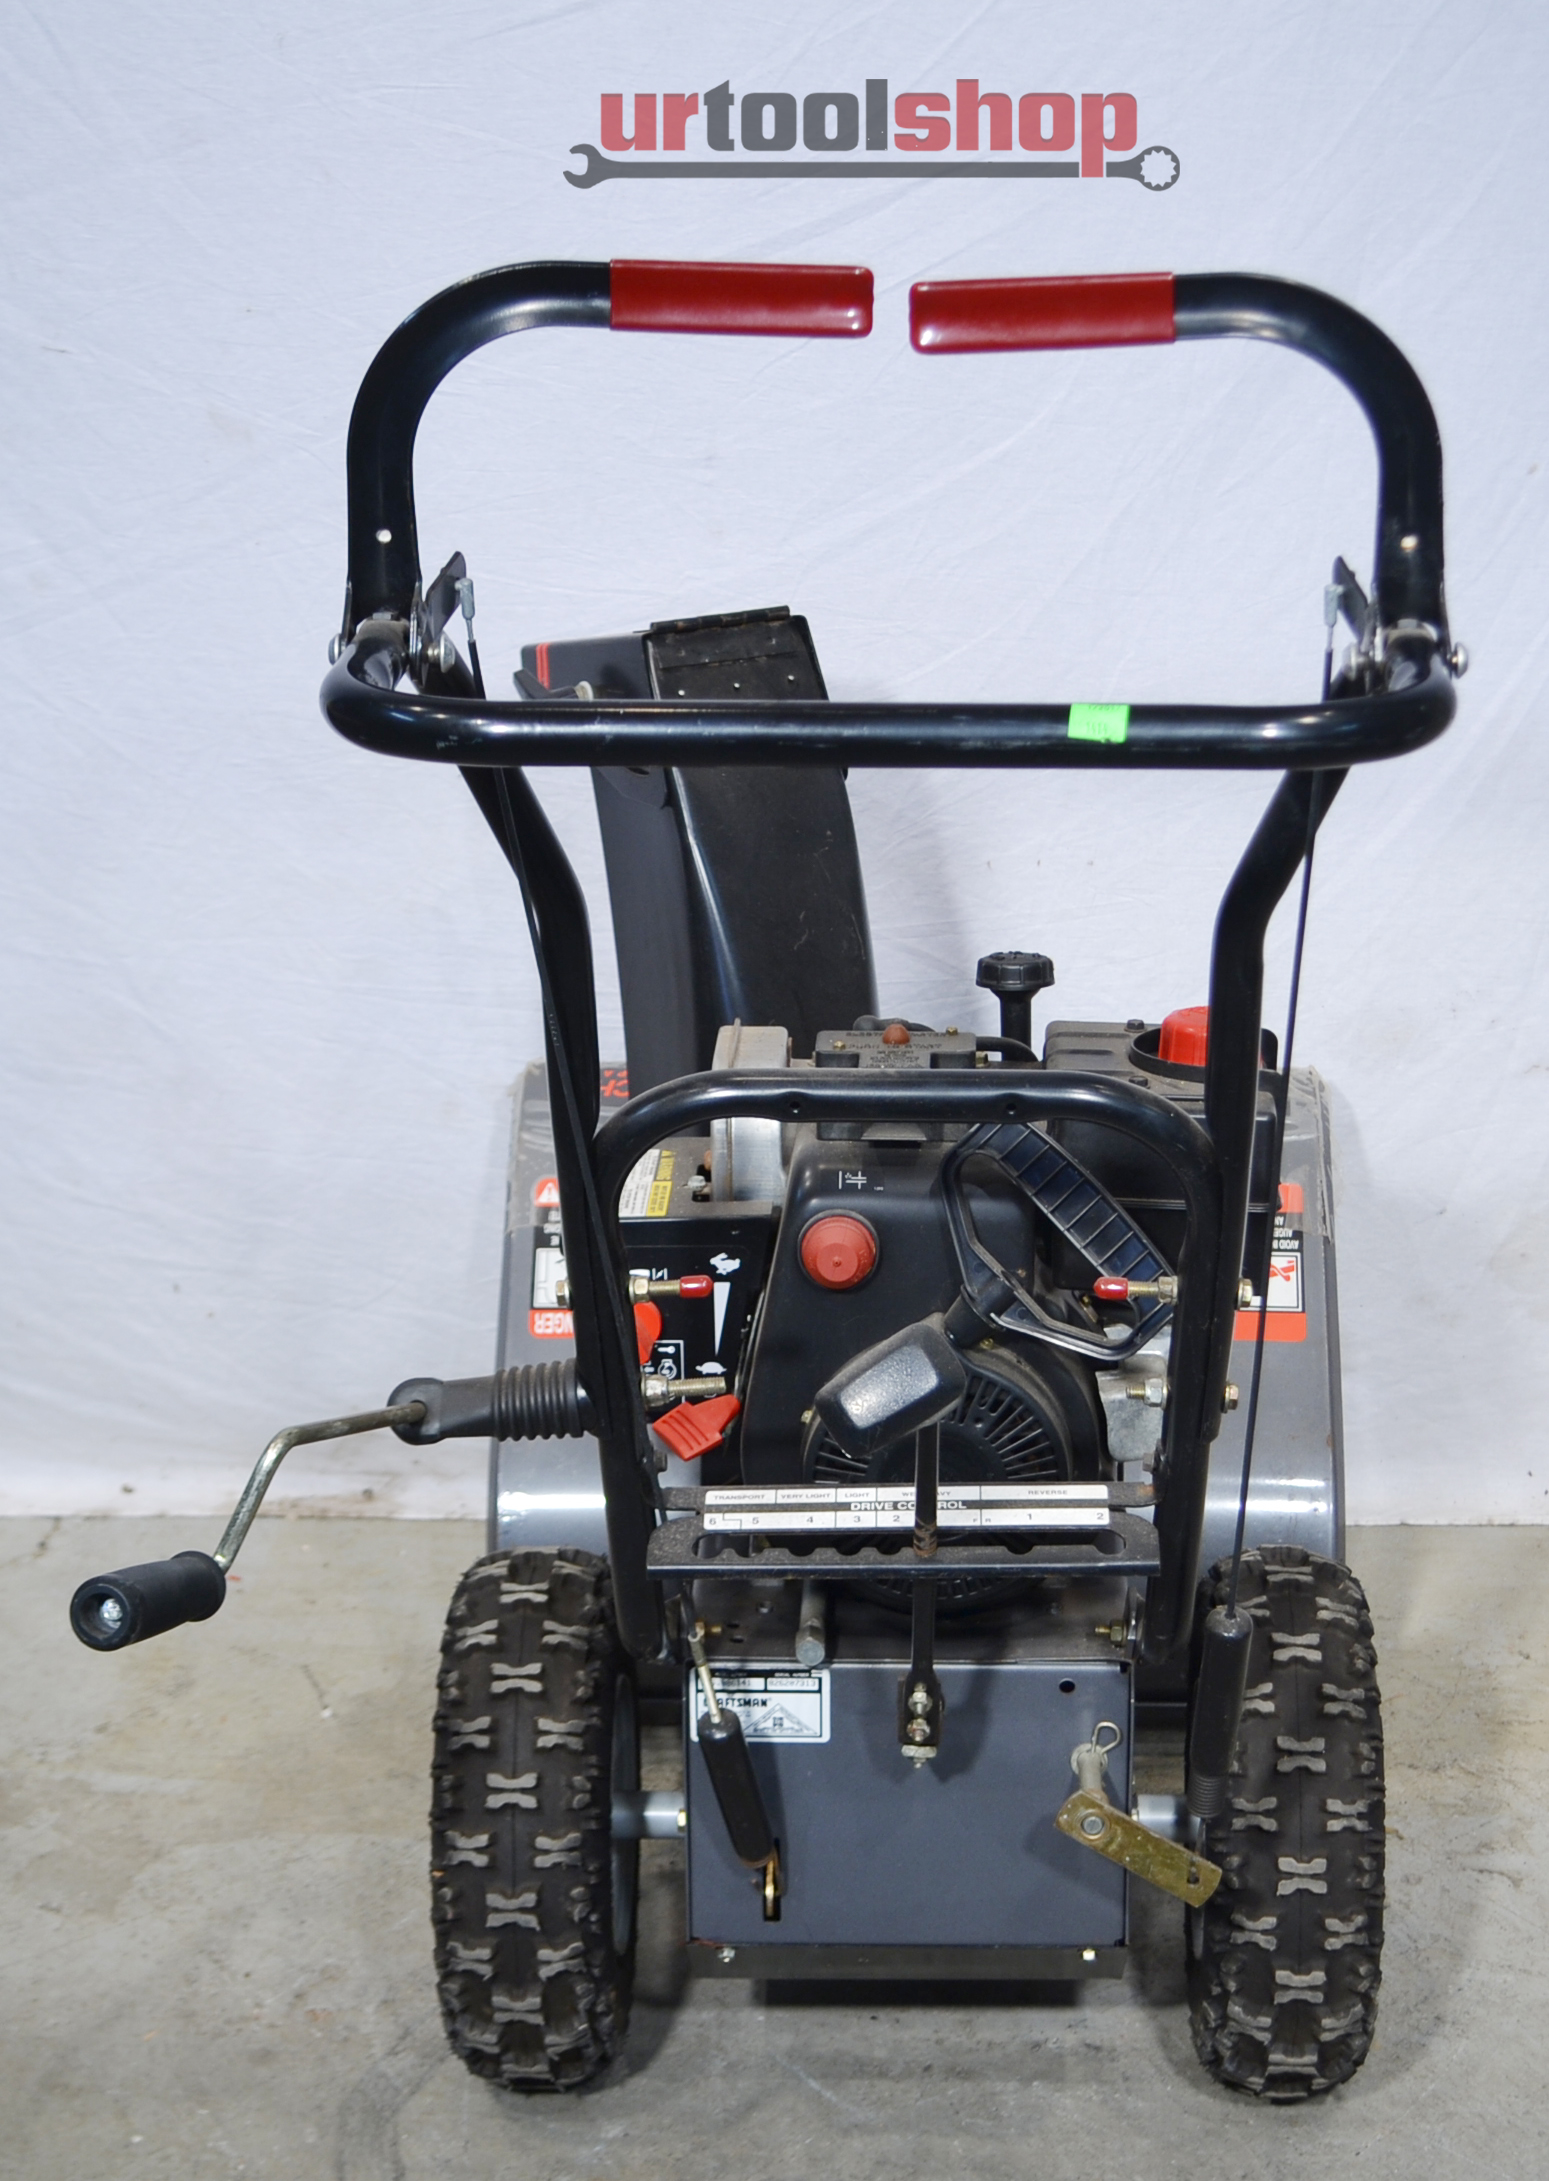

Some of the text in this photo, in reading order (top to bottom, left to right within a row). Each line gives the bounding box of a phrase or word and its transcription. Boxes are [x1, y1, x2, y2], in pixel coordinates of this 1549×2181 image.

[850, 1500, 967, 1511] DRIVE COROL
[806, 1515, 814, 1523] 4
[853, 1515, 861, 1523] 3
[893, 1514, 900, 1522] 2
[1097, 1512, 1104, 1520] 2
[709, 1517, 716, 1525] 6
[752, 1516, 759, 1525] 5
[704, 1698, 768, 1708] CAFTSMAN
